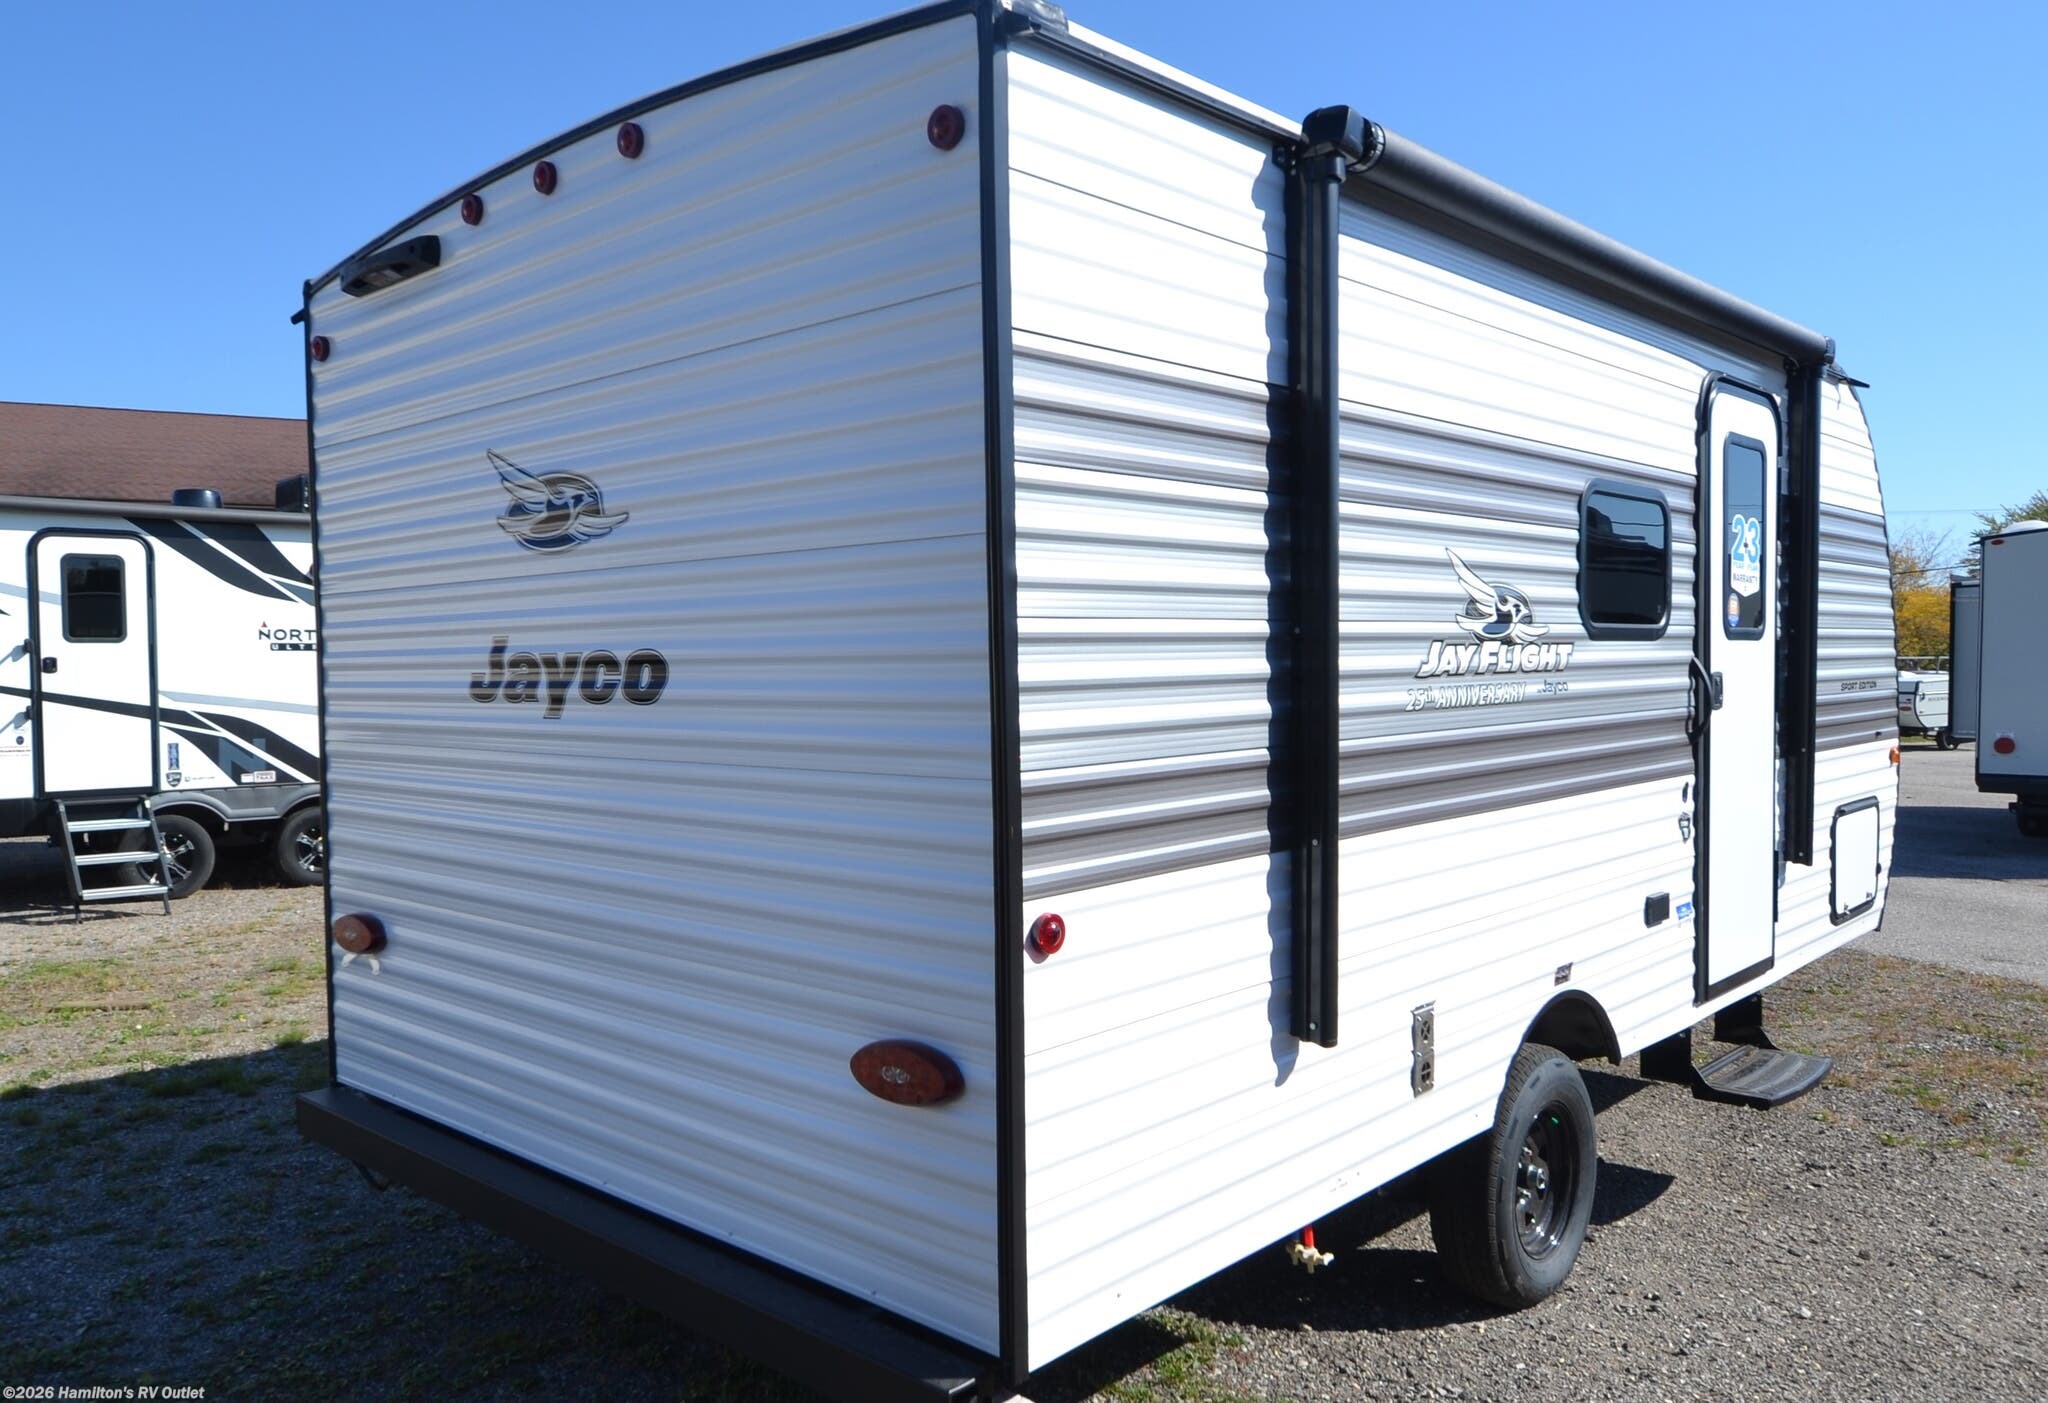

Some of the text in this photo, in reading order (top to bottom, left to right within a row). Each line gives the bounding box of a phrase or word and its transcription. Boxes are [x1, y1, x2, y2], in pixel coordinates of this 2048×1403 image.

[469, 635, 669, 719] Jayco
[1414, 640, 1575, 679] JAY FLIGHT
[1405, 681, 1526, 712] 25th ANNIVERSARY
